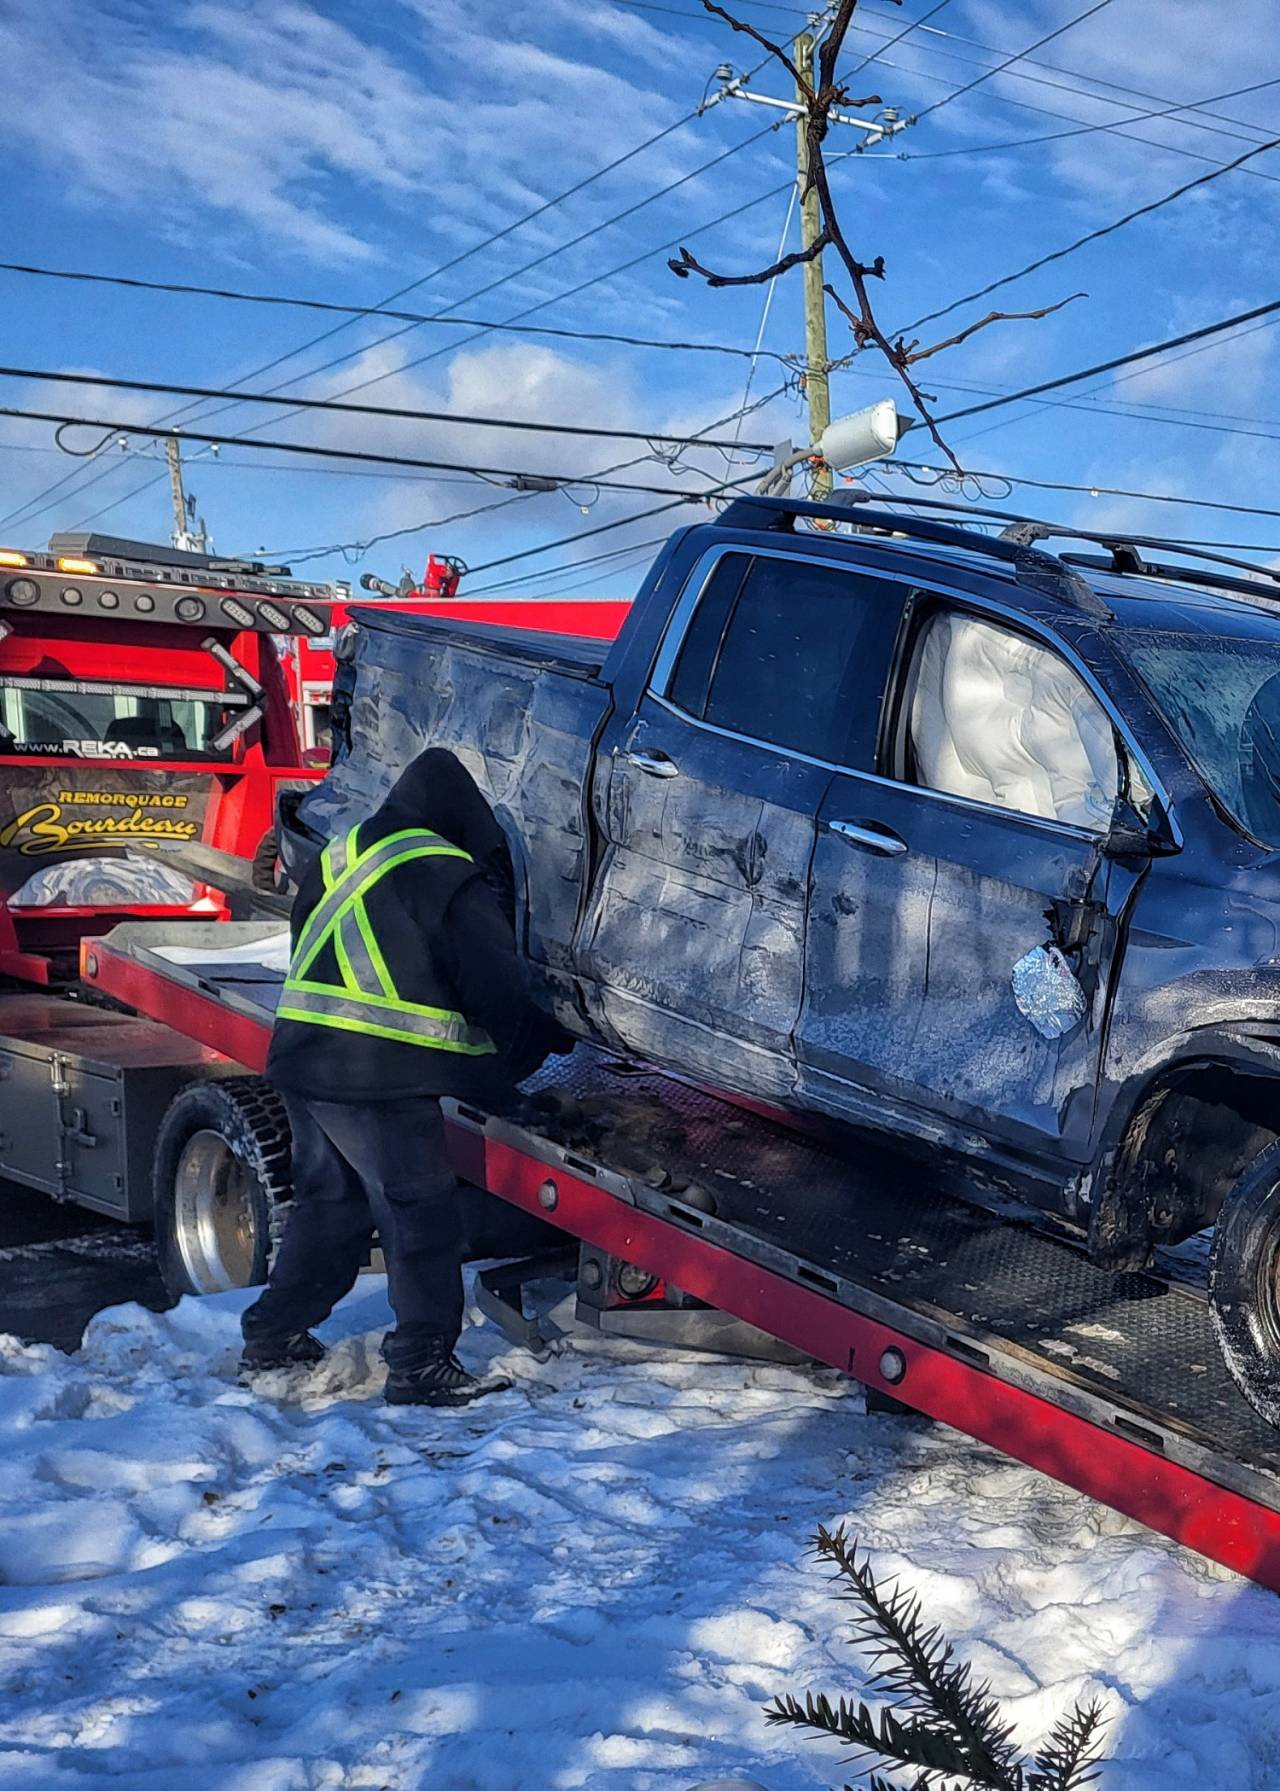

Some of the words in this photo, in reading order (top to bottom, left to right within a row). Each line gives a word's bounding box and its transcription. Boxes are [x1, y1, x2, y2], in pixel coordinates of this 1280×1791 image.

[14, 739, 159, 760] www.REKA.ca
[58, 789, 188, 809] REMORQUAGE
[0, 801, 198, 856] Bourdeau
